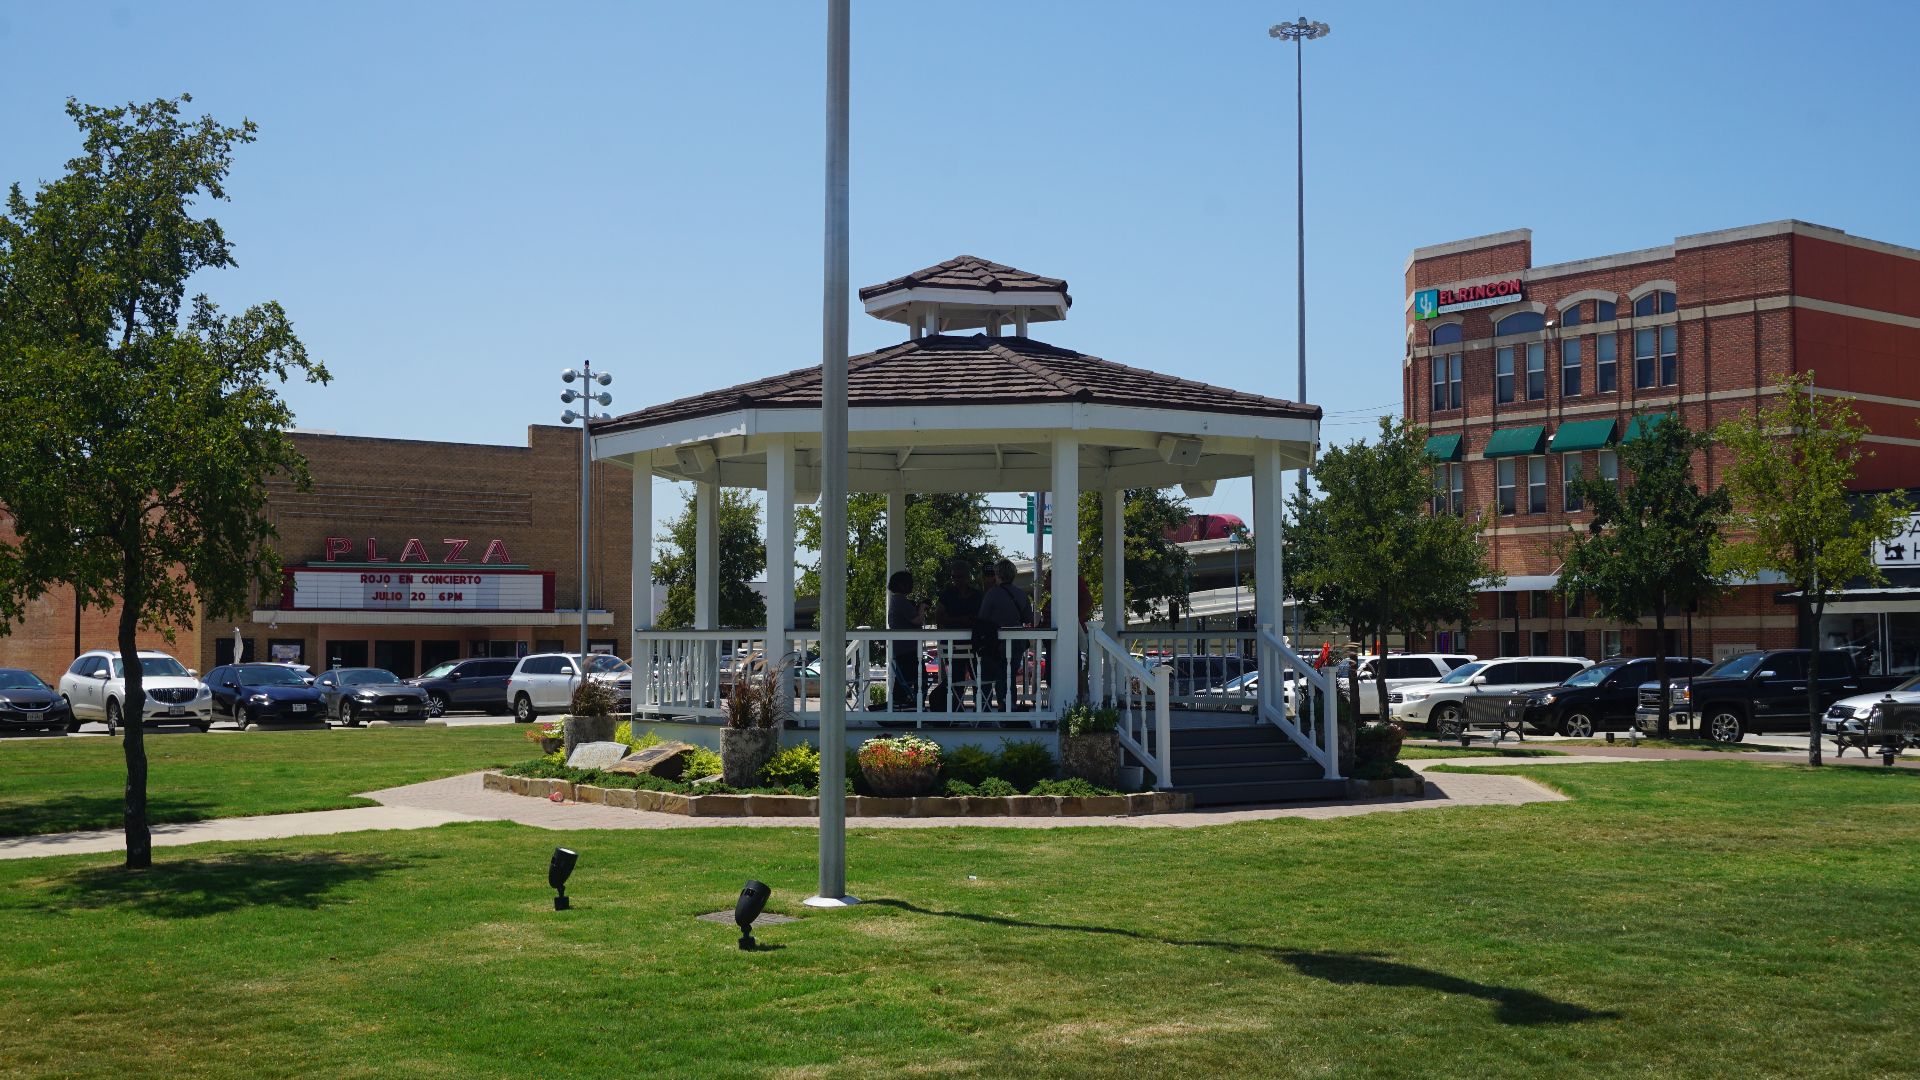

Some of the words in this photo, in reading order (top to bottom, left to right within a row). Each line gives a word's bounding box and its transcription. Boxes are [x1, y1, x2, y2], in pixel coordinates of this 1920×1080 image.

[1439, 291, 1454, 304] EL
[1458, 279, 1521, 301] RINCON
[326, 536, 511, 564] PLAZA
[360, 574, 391, 584] ROJO
[399, 575, 413, 584] EN
[421, 575, 482, 585] CONCIERTO
[371, 592, 402, 601] JULIO
[411, 592, 426, 601] 20
